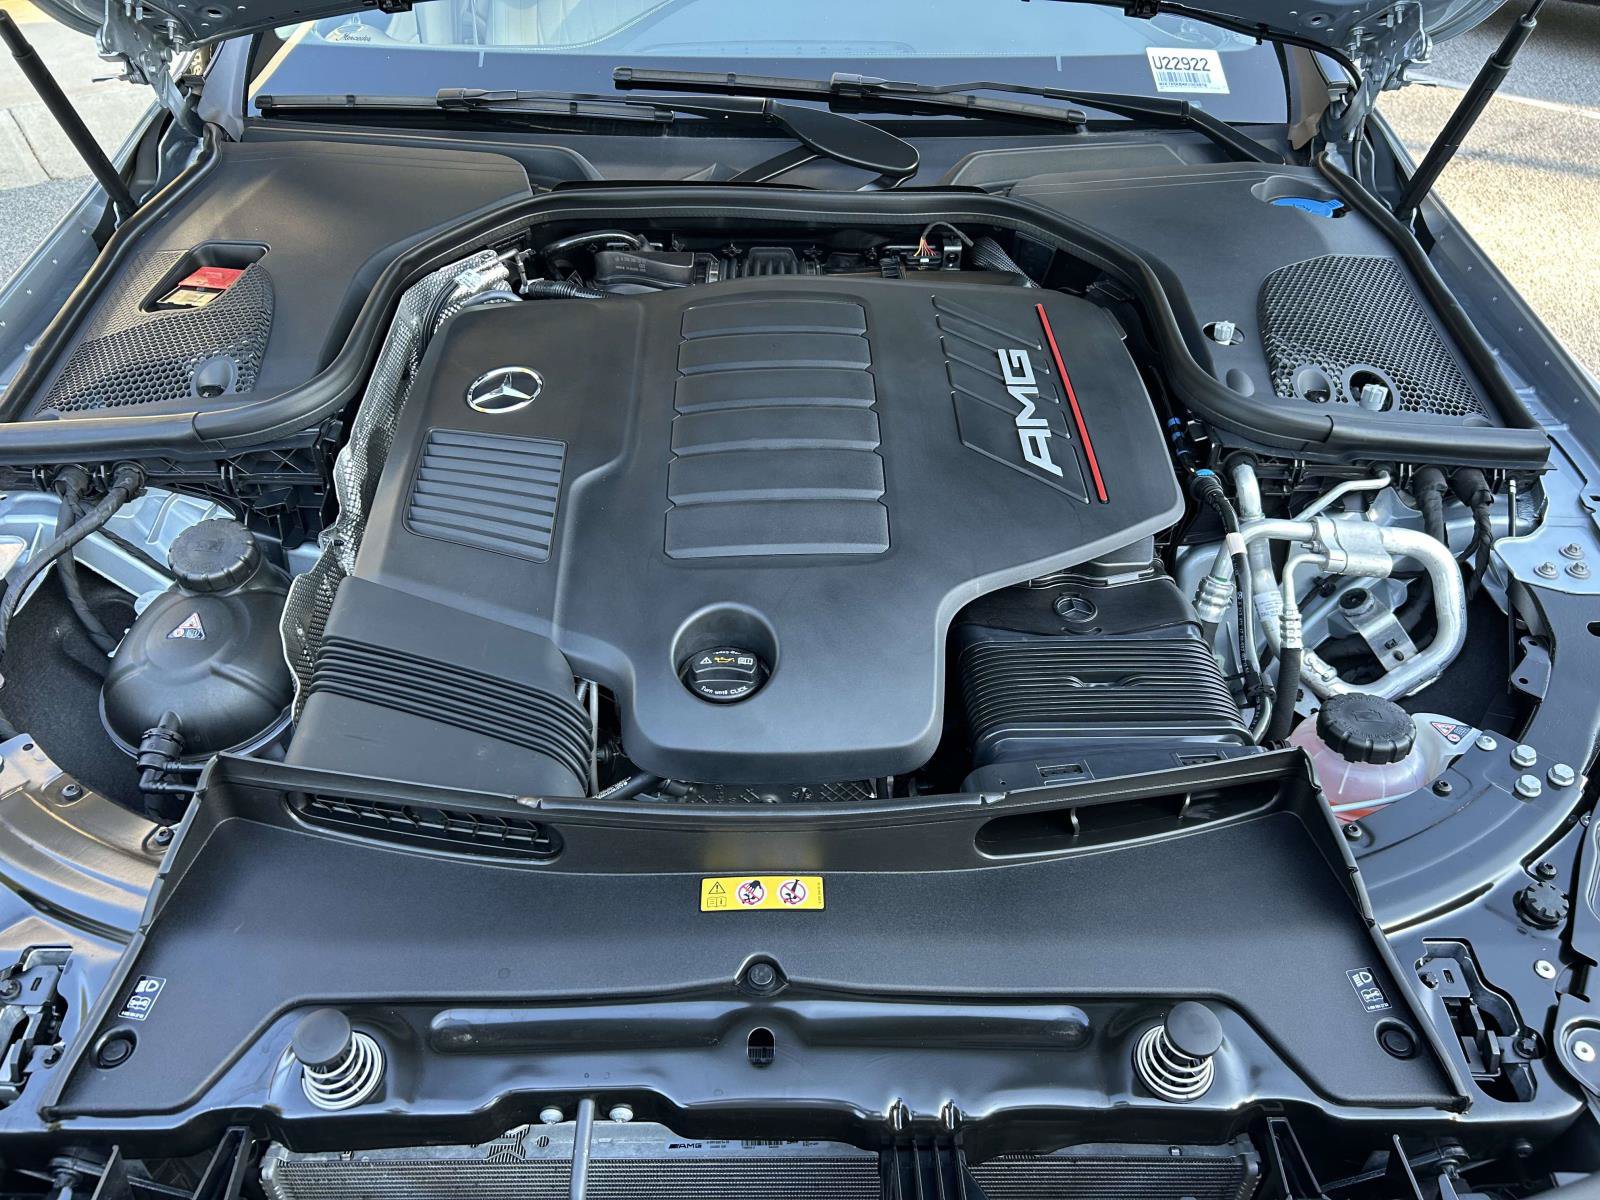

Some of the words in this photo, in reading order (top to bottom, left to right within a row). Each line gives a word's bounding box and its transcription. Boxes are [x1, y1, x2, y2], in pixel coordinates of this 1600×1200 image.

[1152, 56, 1210, 71] U22922
[997, 348, 1064, 478] AMG
[730, 686, 748, 694] CLICK
